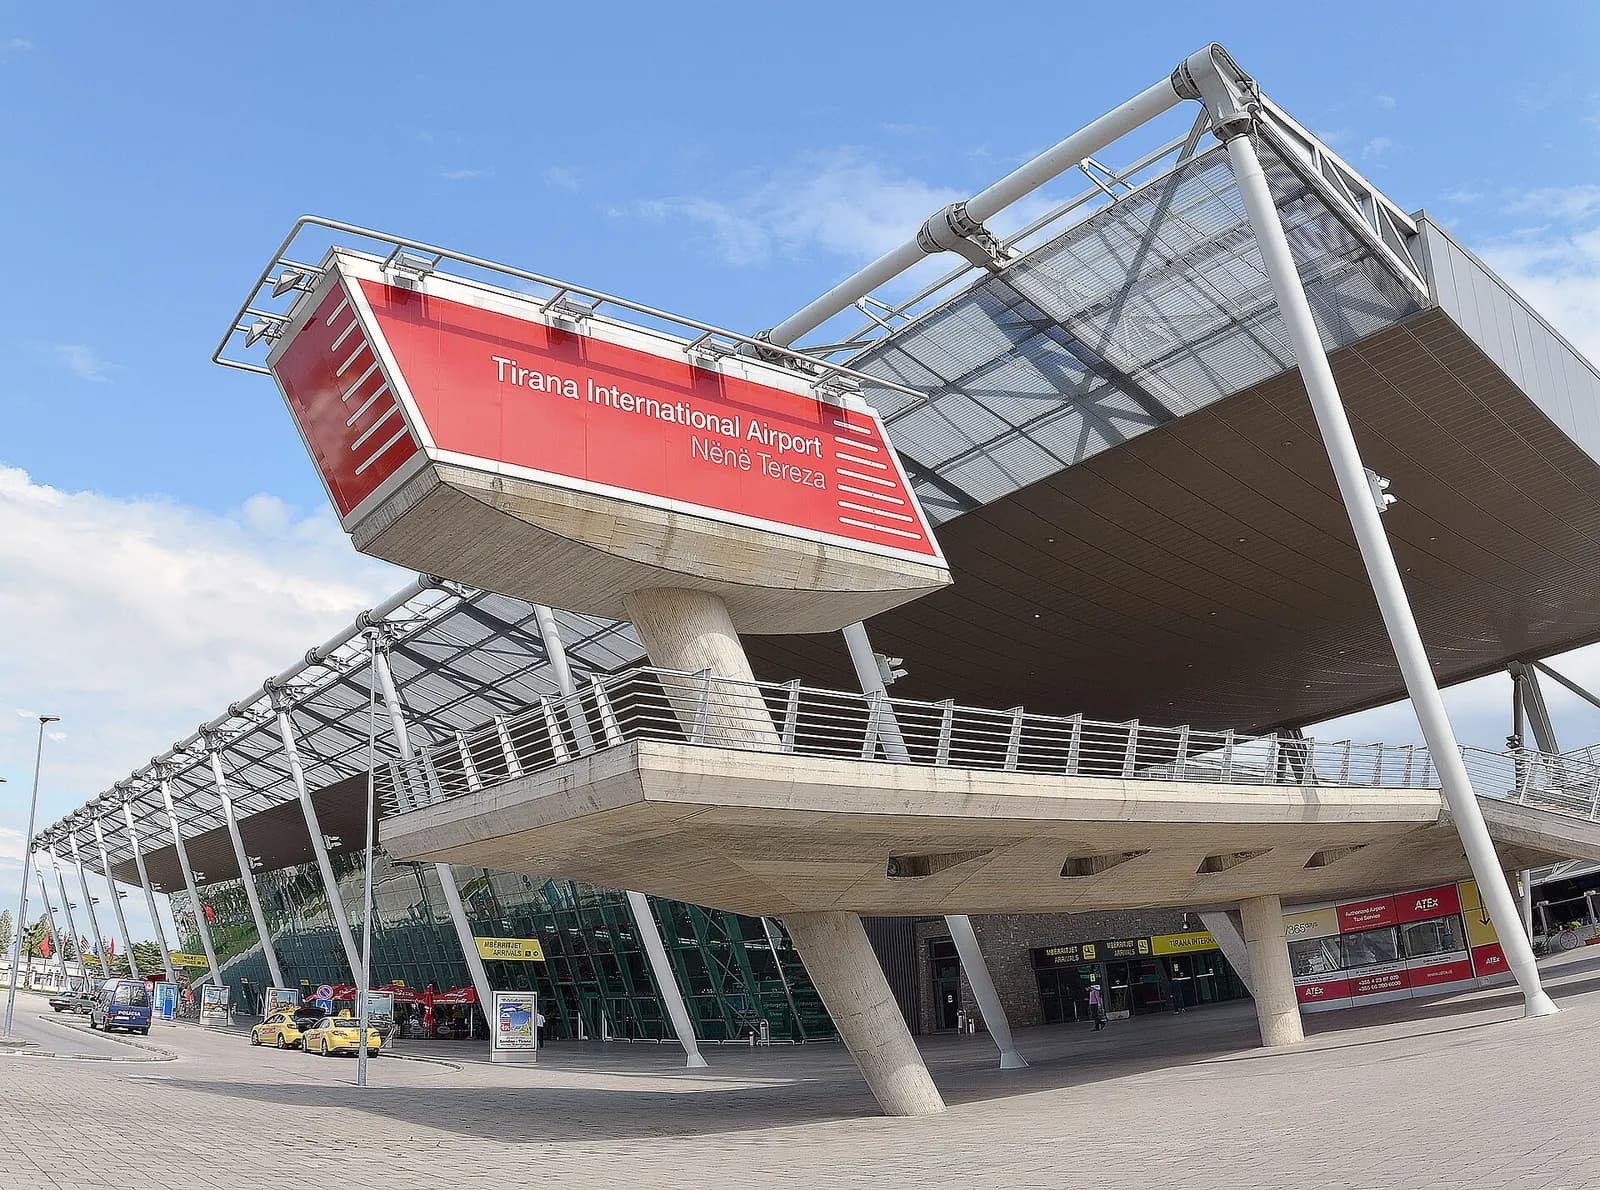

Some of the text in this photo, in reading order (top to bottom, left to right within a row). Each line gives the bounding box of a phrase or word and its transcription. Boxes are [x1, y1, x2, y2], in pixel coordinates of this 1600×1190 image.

[491, 356, 823, 459] Tirana International Airport
[691, 435, 827, 490] Nënë Tereza
[493, 949, 522, 957] ARRIVALS
[1169, 938, 1191, 948] TIRANA
